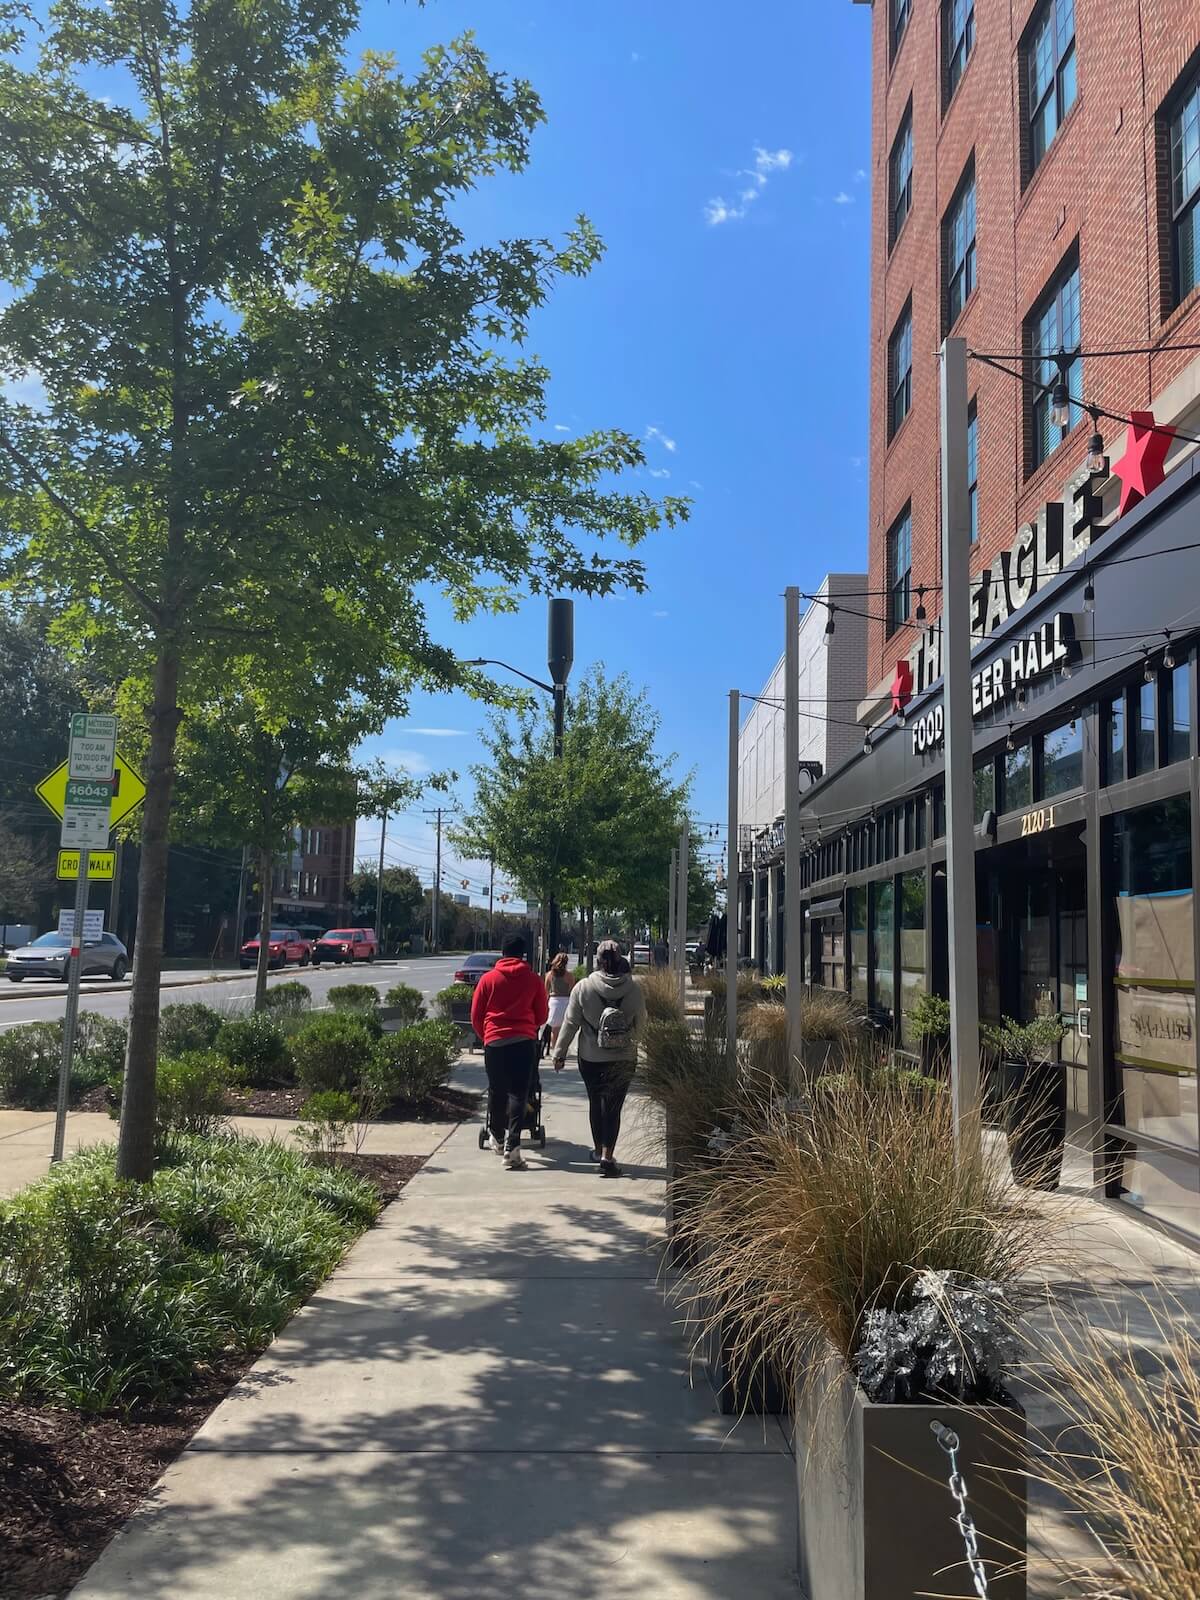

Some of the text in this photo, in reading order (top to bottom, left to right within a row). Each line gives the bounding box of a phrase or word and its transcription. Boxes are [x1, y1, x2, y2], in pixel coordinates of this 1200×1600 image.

[969, 459, 1106, 650] EAGLE
[912, 612, 1069, 755] FOOD EER HALL
[74, 753, 82, 761] TO
[96, 764, 108, 772] SAT
[69, 785, 109, 797] 46043
[61, 859, 112, 872] CROWALK
